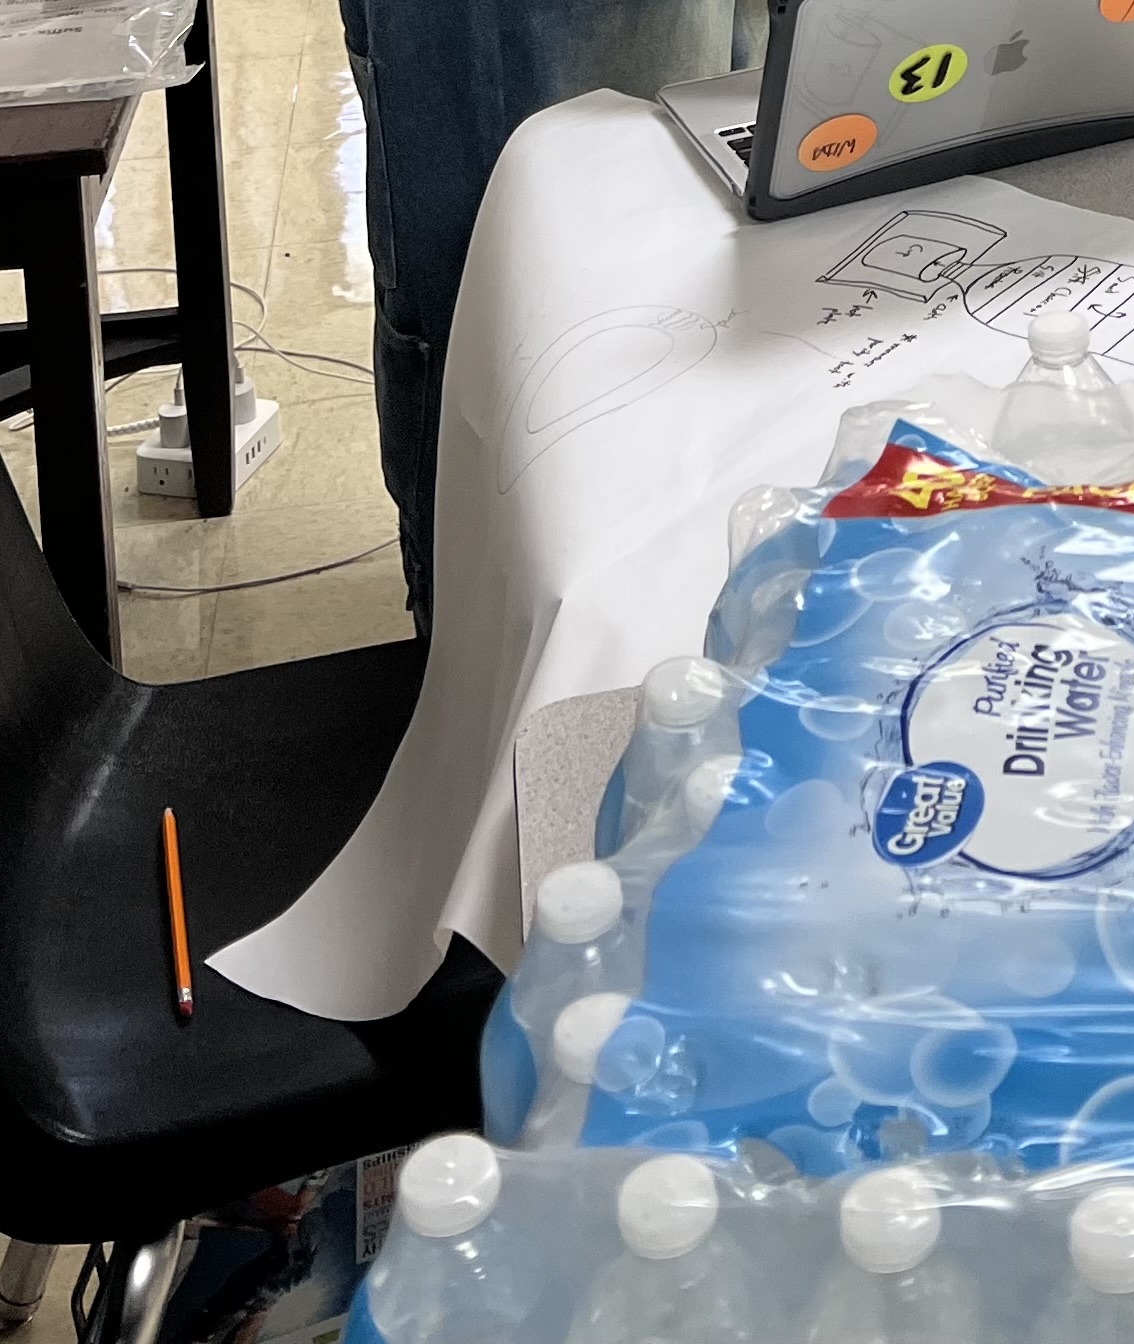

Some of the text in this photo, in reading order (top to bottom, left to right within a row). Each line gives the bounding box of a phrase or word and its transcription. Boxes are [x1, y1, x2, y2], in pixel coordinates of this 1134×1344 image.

[38, 26, 84, 35] Suffix
[900, 51, 953, 96] 13
[973, 636, 1021, 718] Purified
[1002, 643, 1074, 778] Drinking
[1053, 649, 1110, 741] Water
[887, 774, 946, 856] Great
[926, 777, 967, 839] Value
